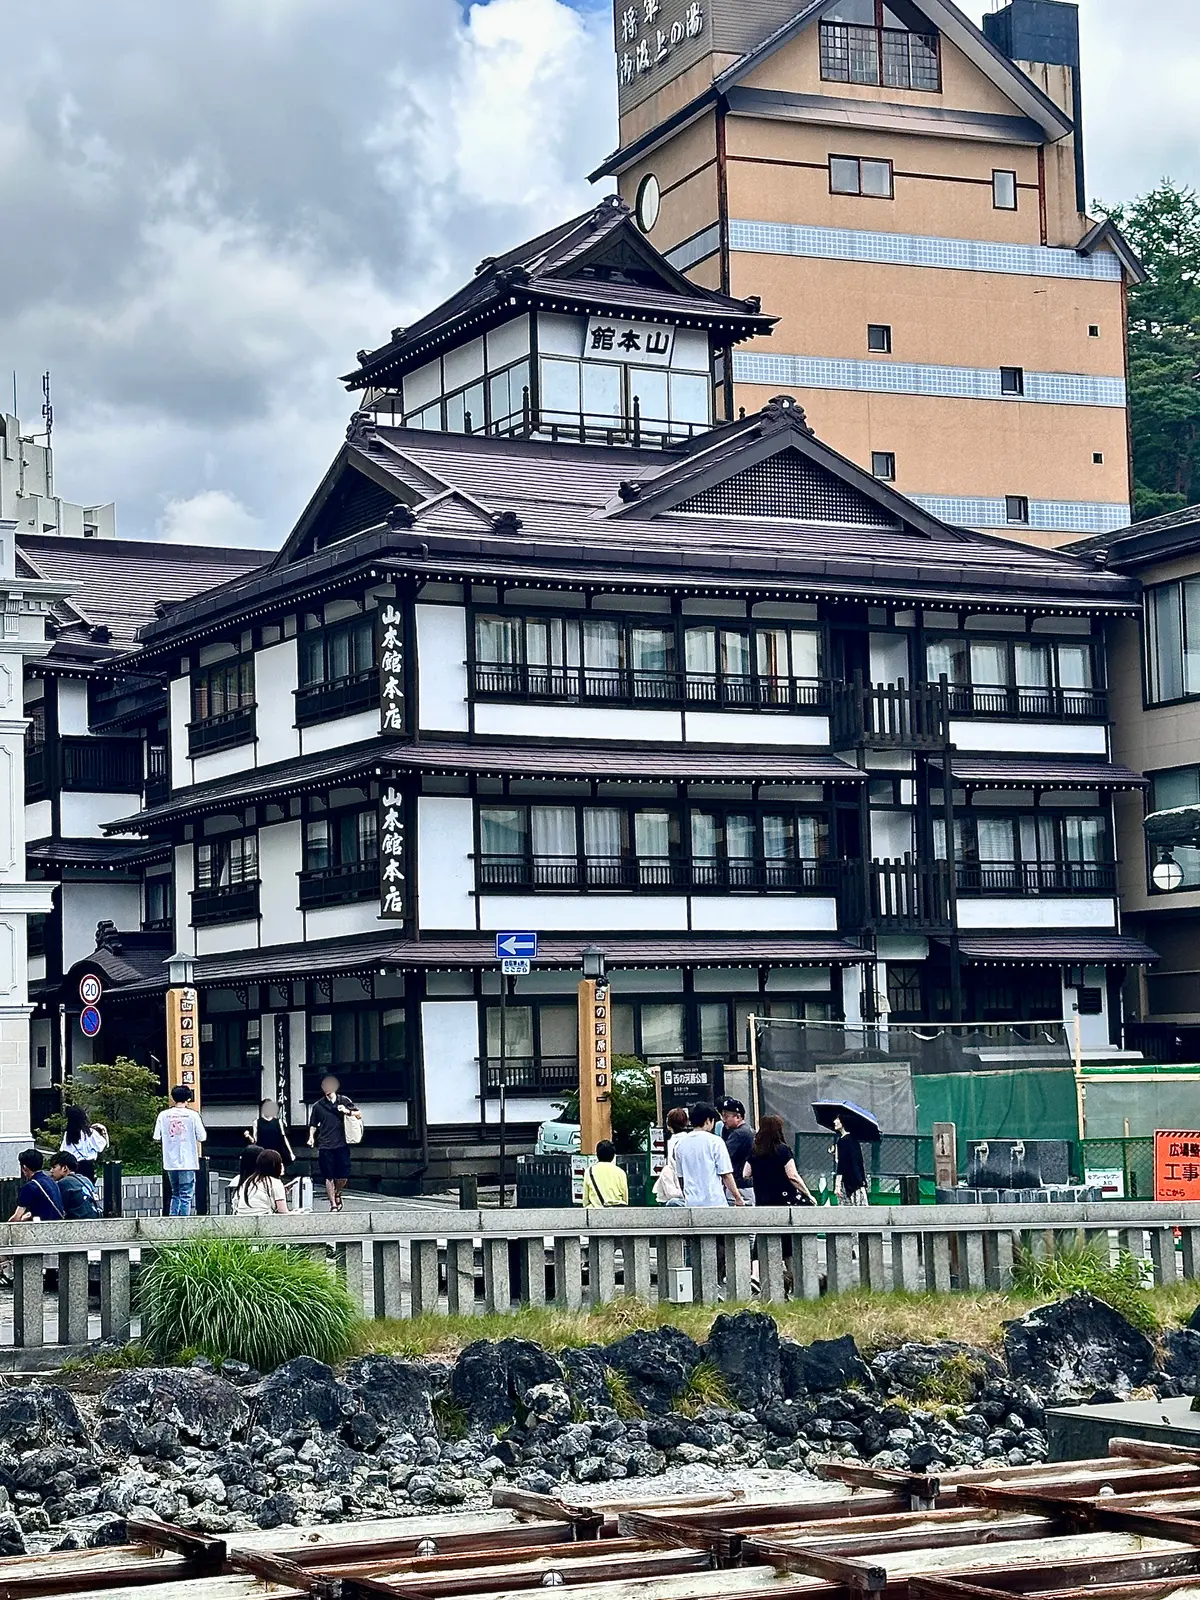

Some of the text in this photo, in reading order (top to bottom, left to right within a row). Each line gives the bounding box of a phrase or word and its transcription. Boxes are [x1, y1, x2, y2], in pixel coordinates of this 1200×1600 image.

[381, 605, 404, 729] 山本館本店
[381, 787, 405, 912] 山本館本店
[85, 983, 97, 996] 20
[1163, 1163, 1200, 1181] 工事
[1159, 1189, 1186, 1197] ここから
